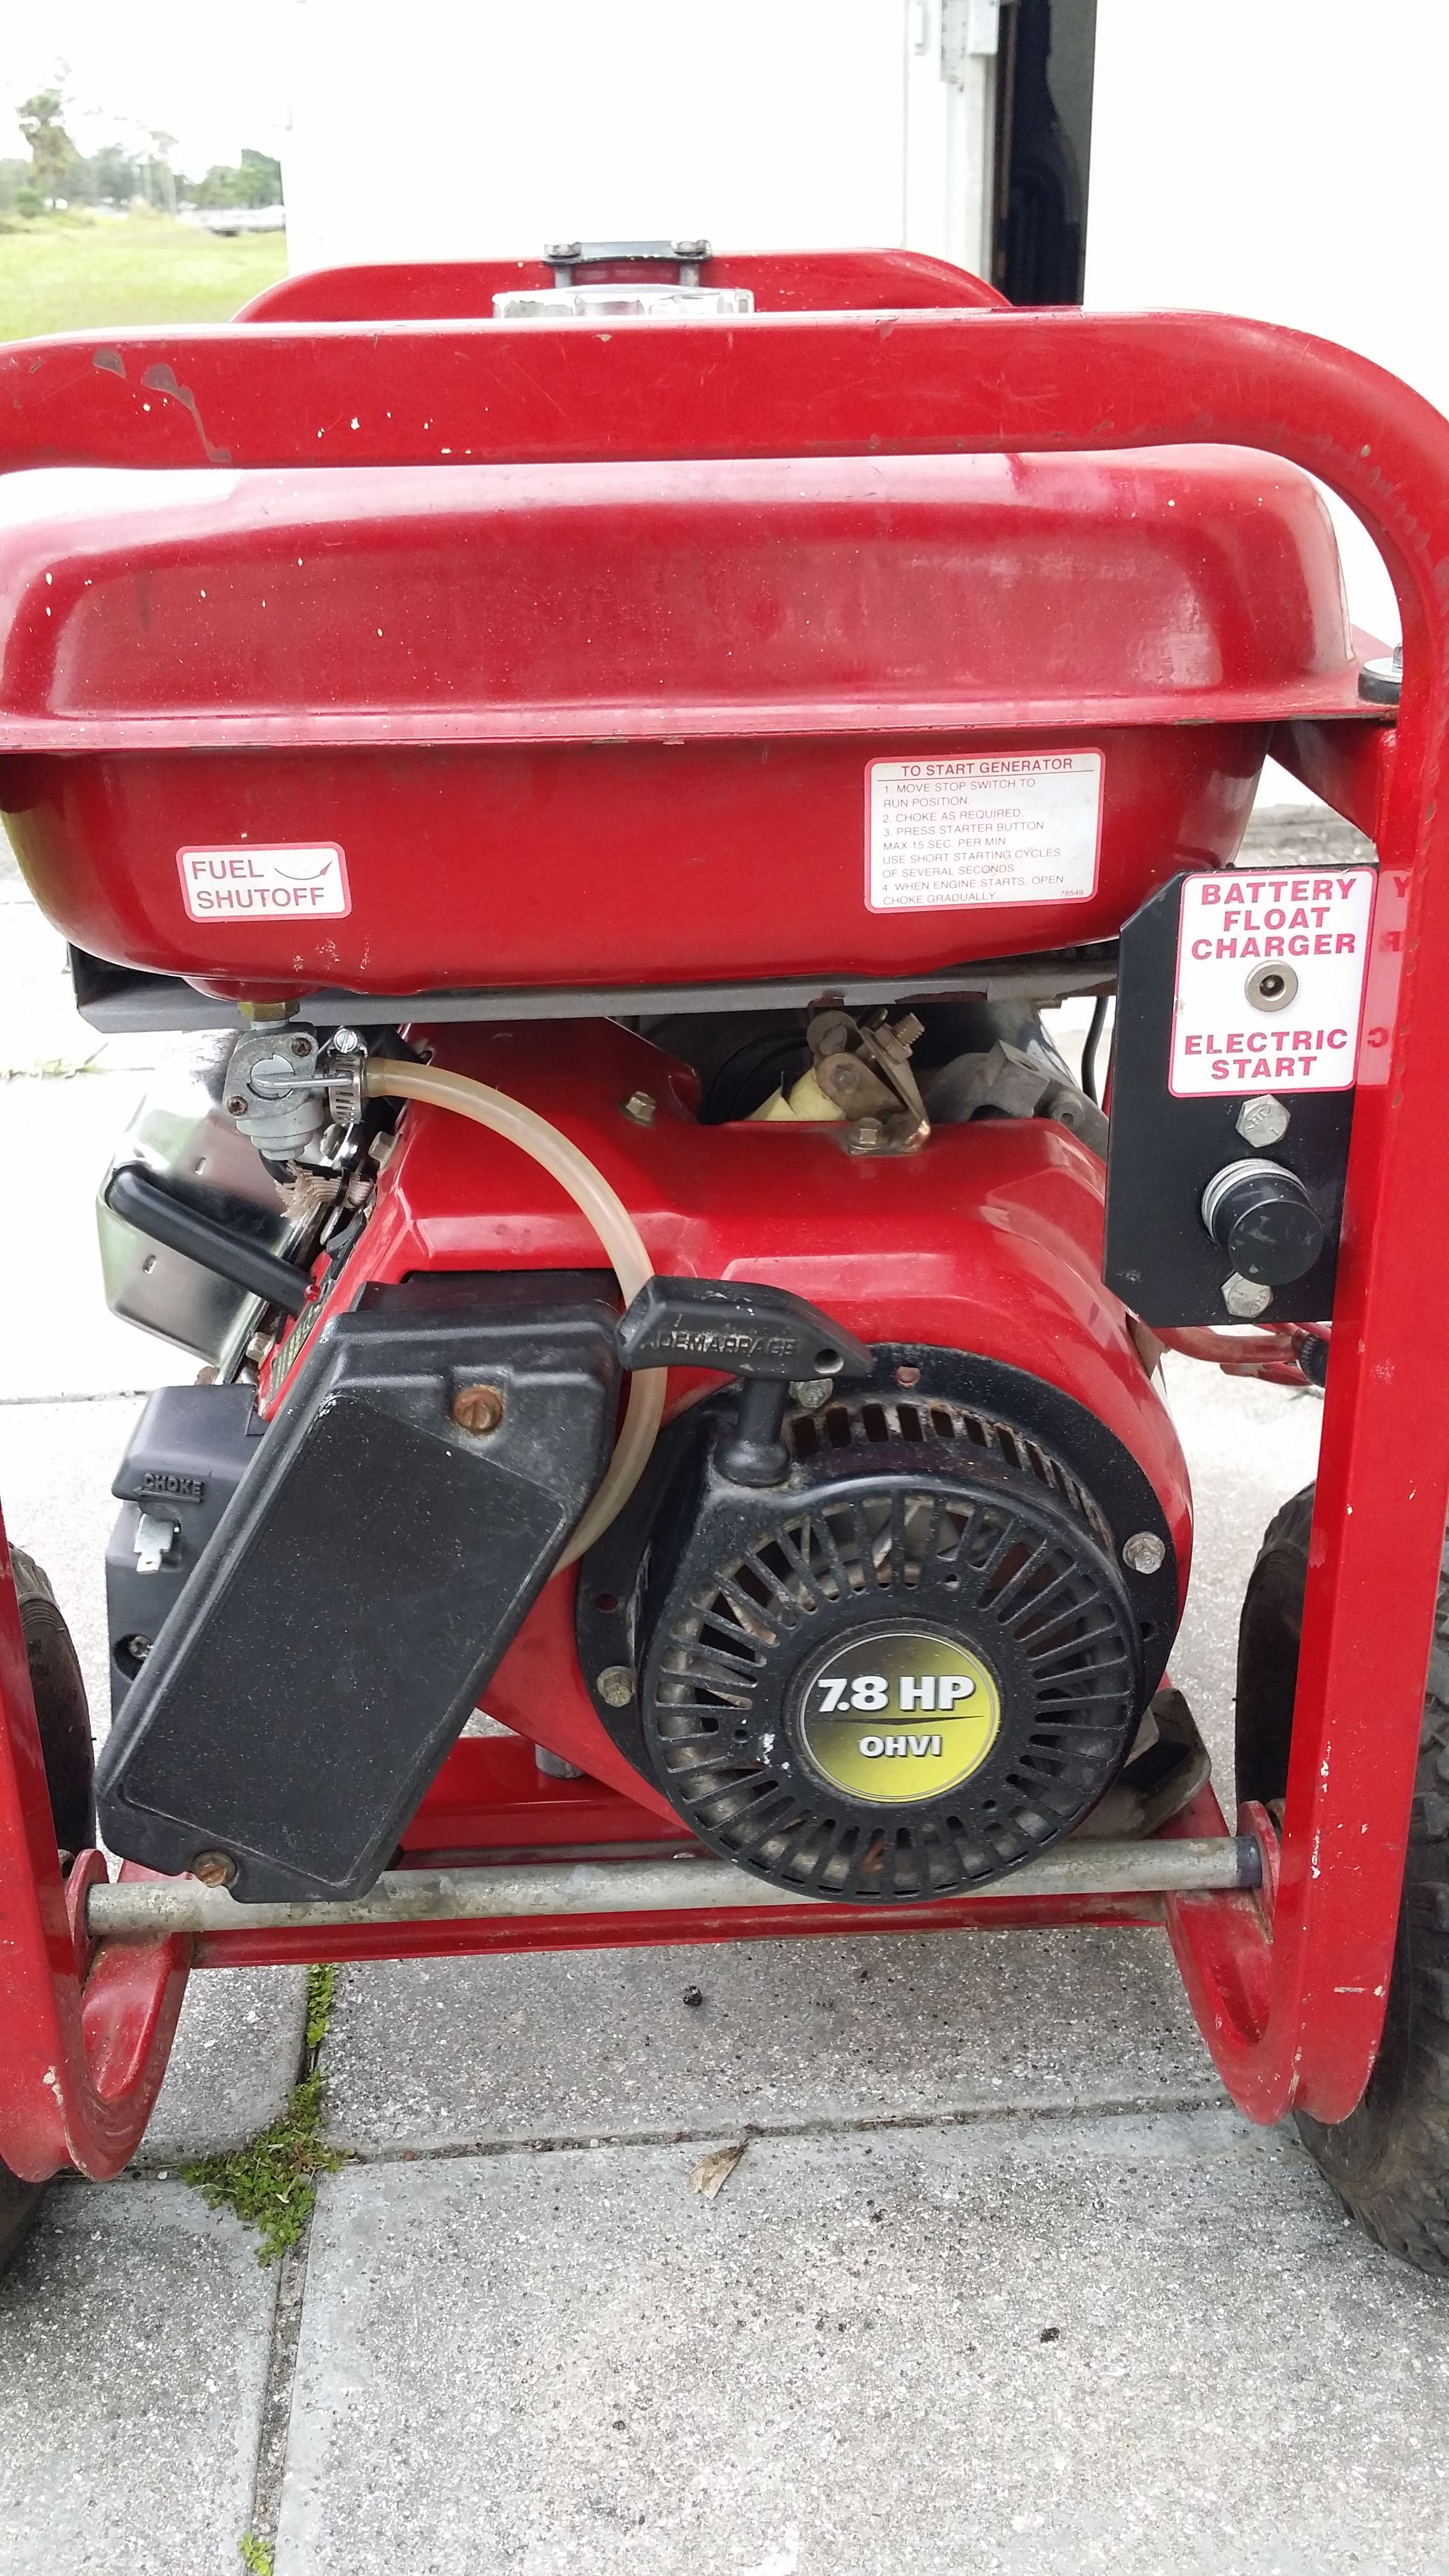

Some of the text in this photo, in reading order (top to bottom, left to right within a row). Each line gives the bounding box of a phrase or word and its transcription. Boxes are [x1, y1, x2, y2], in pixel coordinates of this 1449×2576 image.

[902, 758, 1072, 777] TO START GENERATOR
[897, 783, 930, 793] MOVE
[935, 781, 966, 791] STOP
[970, 779, 1015, 790] SWITCH
[1020, 778, 1035, 788] TO
[884, 799, 908, 808] RUN
[896, 812, 937, 822] CHOKE
[941, 811, 956, 821] AS
[884, 821, 1044, 837] 3. PRESS STARTER BUTTON
[884, 841, 907, 851] MAX
[913, 841, 924, 849] 15
[929, 839, 954, 849] SEC.
[959, 838, 980, 847] PER
[883, 848, 1060, 864] USE SHORT STARTING CYCLES
[192, 860, 264, 880] FUEL
[882, 869, 898, 878] OF
[902, 867, 954, 877] SEVERAL
[895, 882, 929, 892] WHEN
[934, 879, 976, 889] ENGINE
[1032, 875, 1063, 884] OPEN
[1201, 878, 1357, 905] BATTERY
[197, 887, 324, 909] SHUTOFF
[883, 895, 922, 905] CHOKE
[1224, 907, 1330, 932] FLOAT
[1191, 934, 1355, 960] CHARGER
[1185, 1029, 1348, 1055] ELECTRIC
[1211, 1056, 1317, 1080] START
[144, 1472, 203, 1495] CHOKE
[818, 1675, 975, 1712] 7.8 HP
[859, 1735, 942, 1758] OHVI
